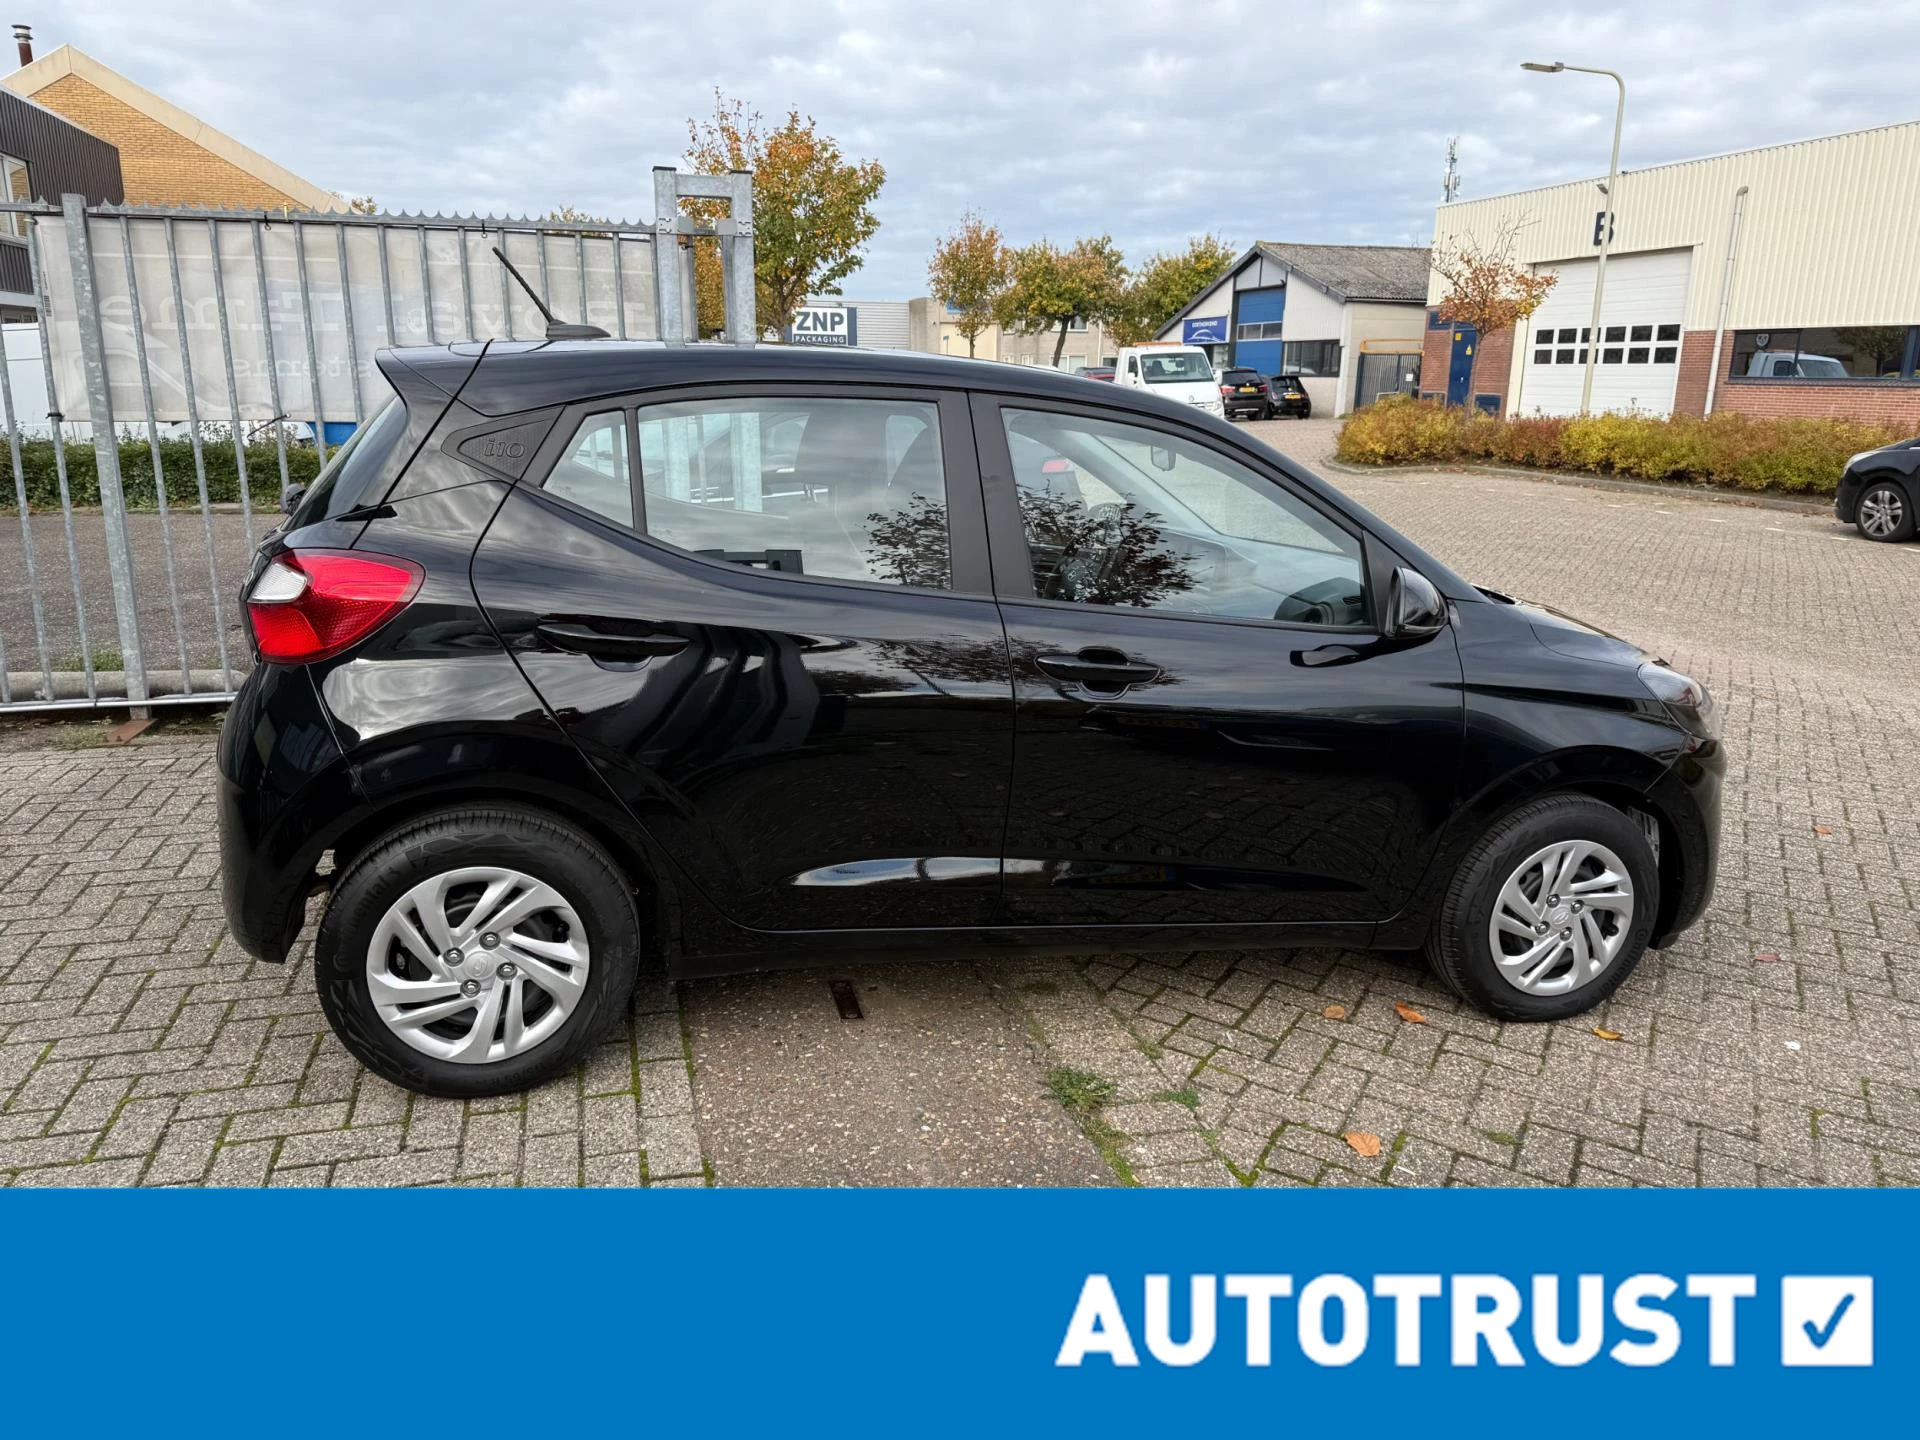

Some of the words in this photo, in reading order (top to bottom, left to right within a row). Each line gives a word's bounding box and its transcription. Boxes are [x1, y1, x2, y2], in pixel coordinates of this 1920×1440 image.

[1593, 211, 1615, 247] B
[796, 311, 844, 332] ZNP
[795, 334, 845, 343] PACKAGING
